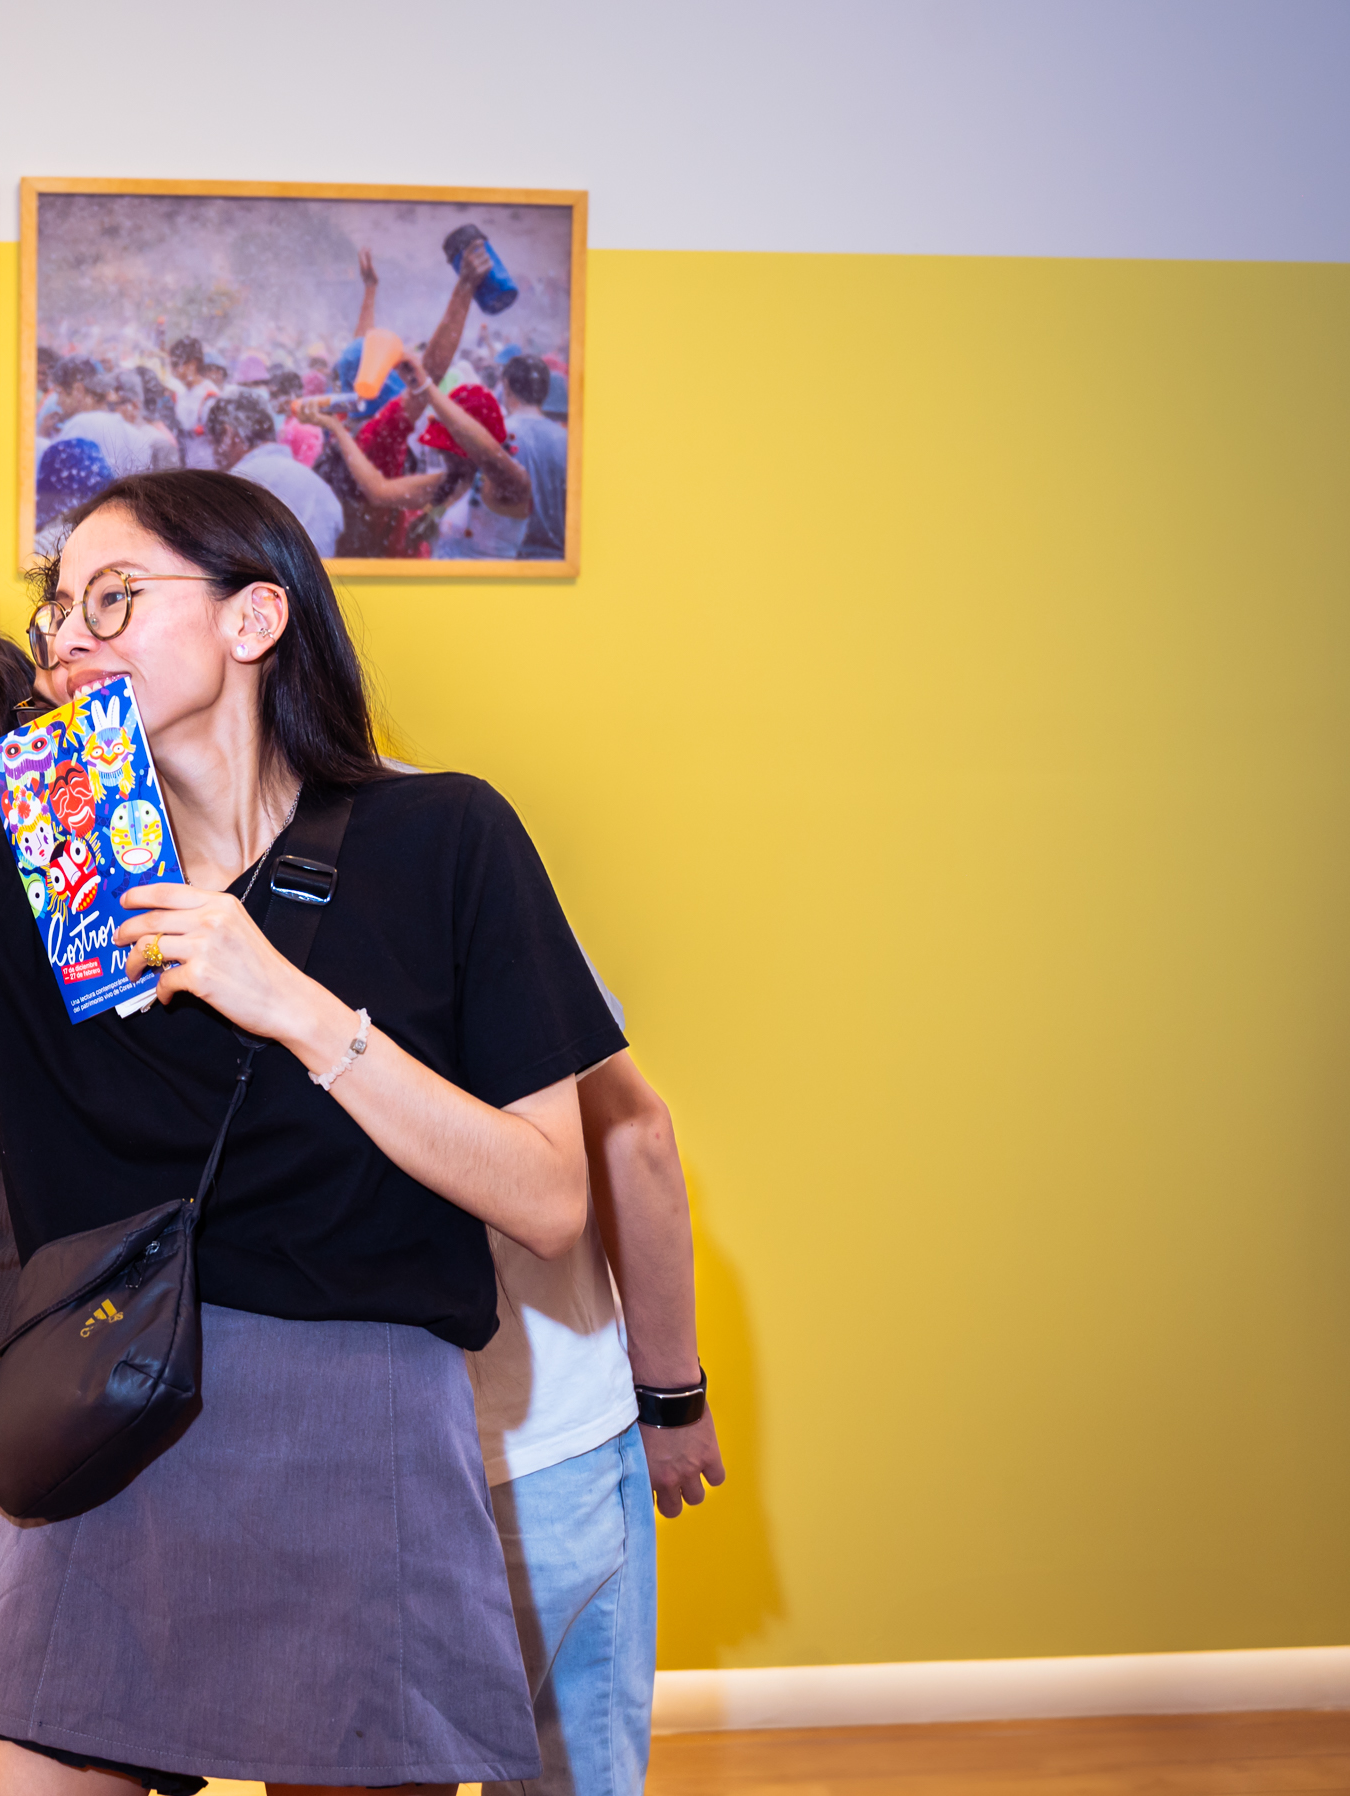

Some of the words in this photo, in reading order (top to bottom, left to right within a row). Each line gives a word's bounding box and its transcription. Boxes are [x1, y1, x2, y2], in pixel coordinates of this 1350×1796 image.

[75, 961, 98, 971] diciembre
[83, 967, 101, 977] febrero
[71, 998, 80, 1006] Una
[80, 991, 96, 1002] lectura
[96, 976, 129, 995] contemporánea
[73, 1005, 81, 1013] del
[81, 995, 104, 1011] patrimonio
[104, 990, 113, 1000] vivo
[113, 988, 120, 996] de
[119, 982, 133, 992] Corea
